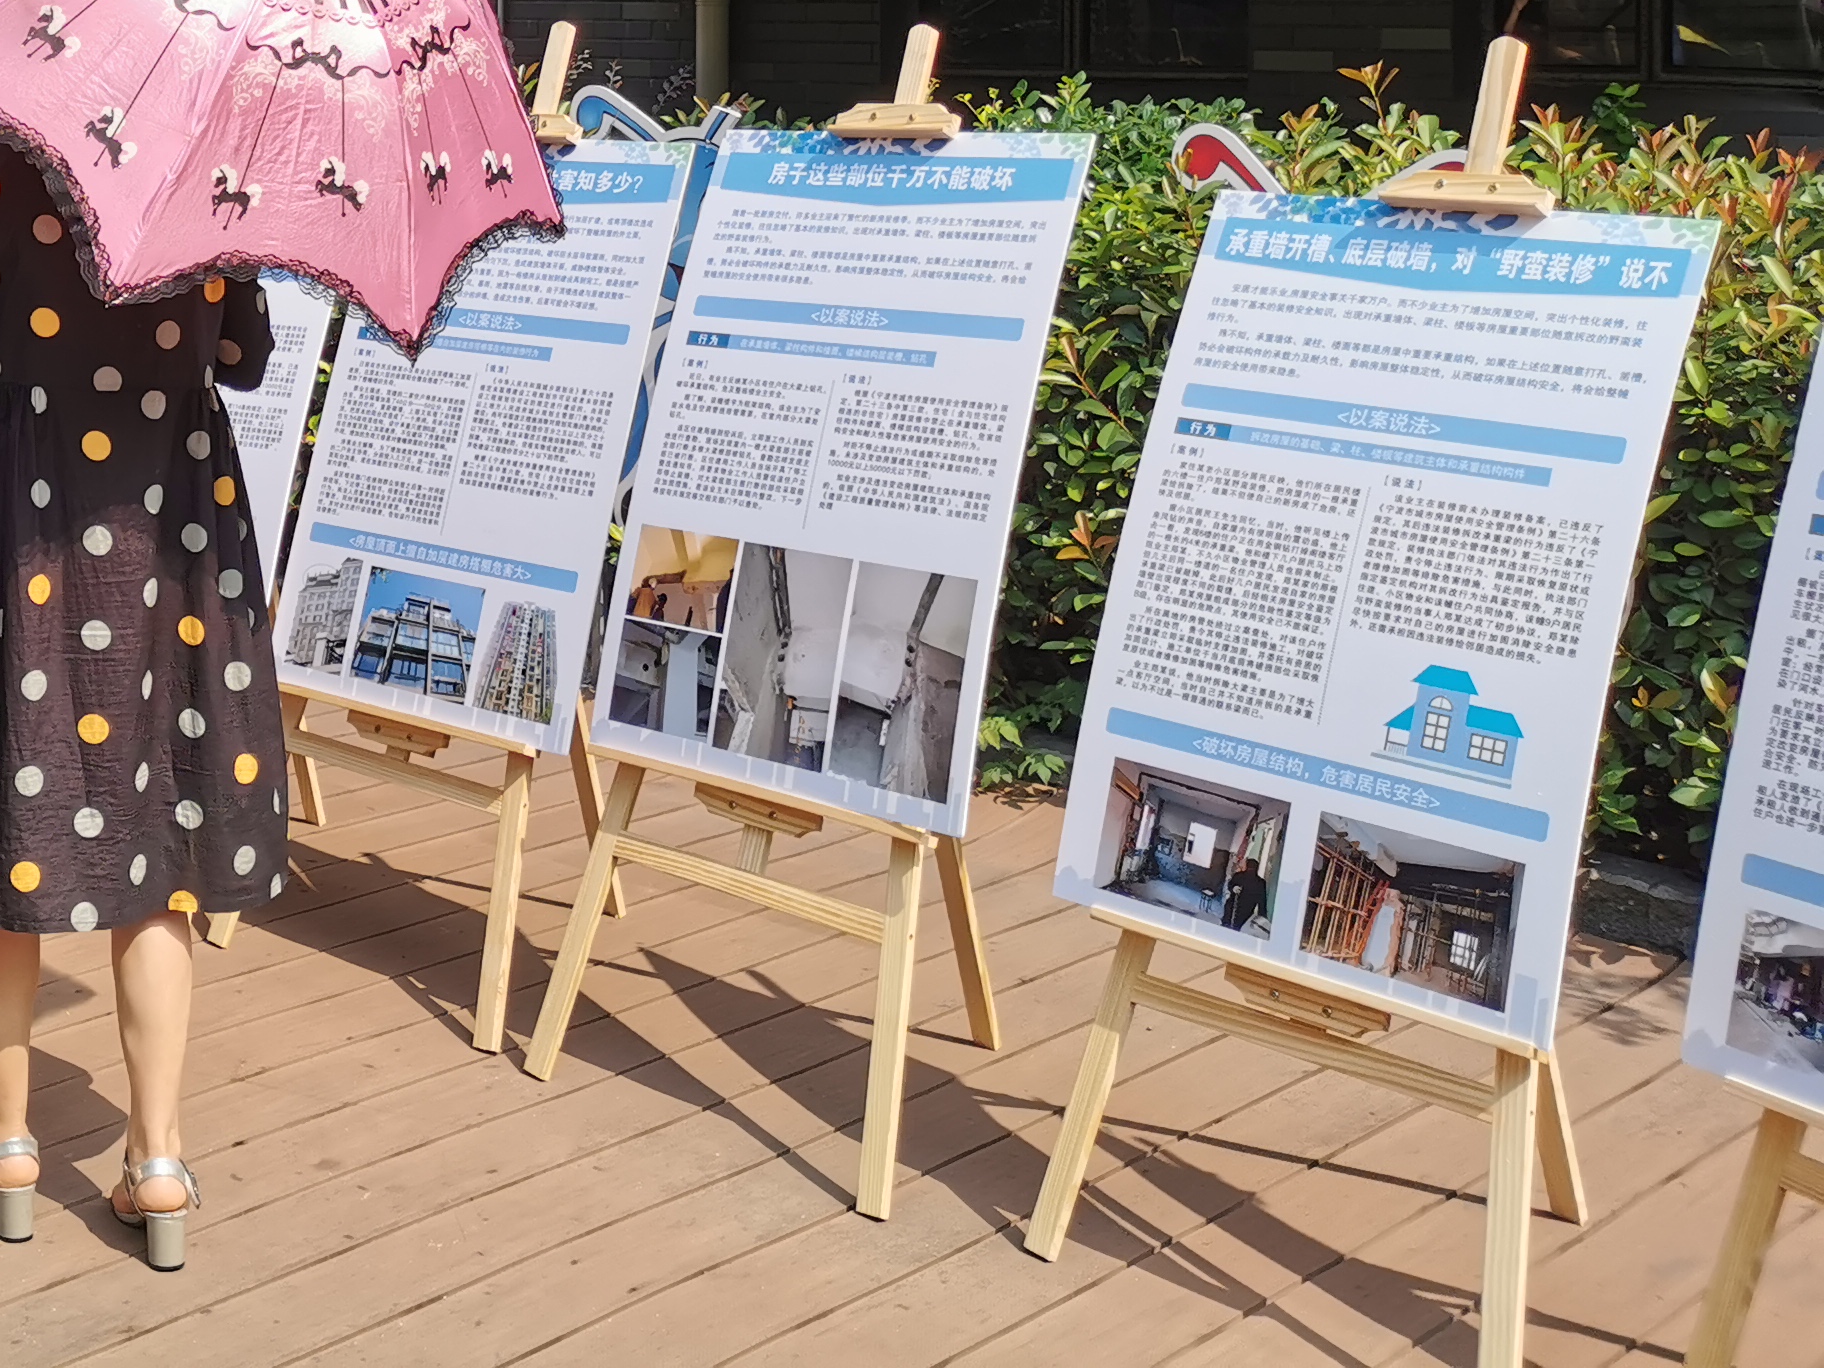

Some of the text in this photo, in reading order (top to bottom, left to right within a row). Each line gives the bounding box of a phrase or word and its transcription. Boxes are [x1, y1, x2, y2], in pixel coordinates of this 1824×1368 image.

[767, 161, 1016, 191] 房子这些部位千万不能破坏
[696, 333, 719, 345] 行为
[1188, 421, 1217, 437] 行为
